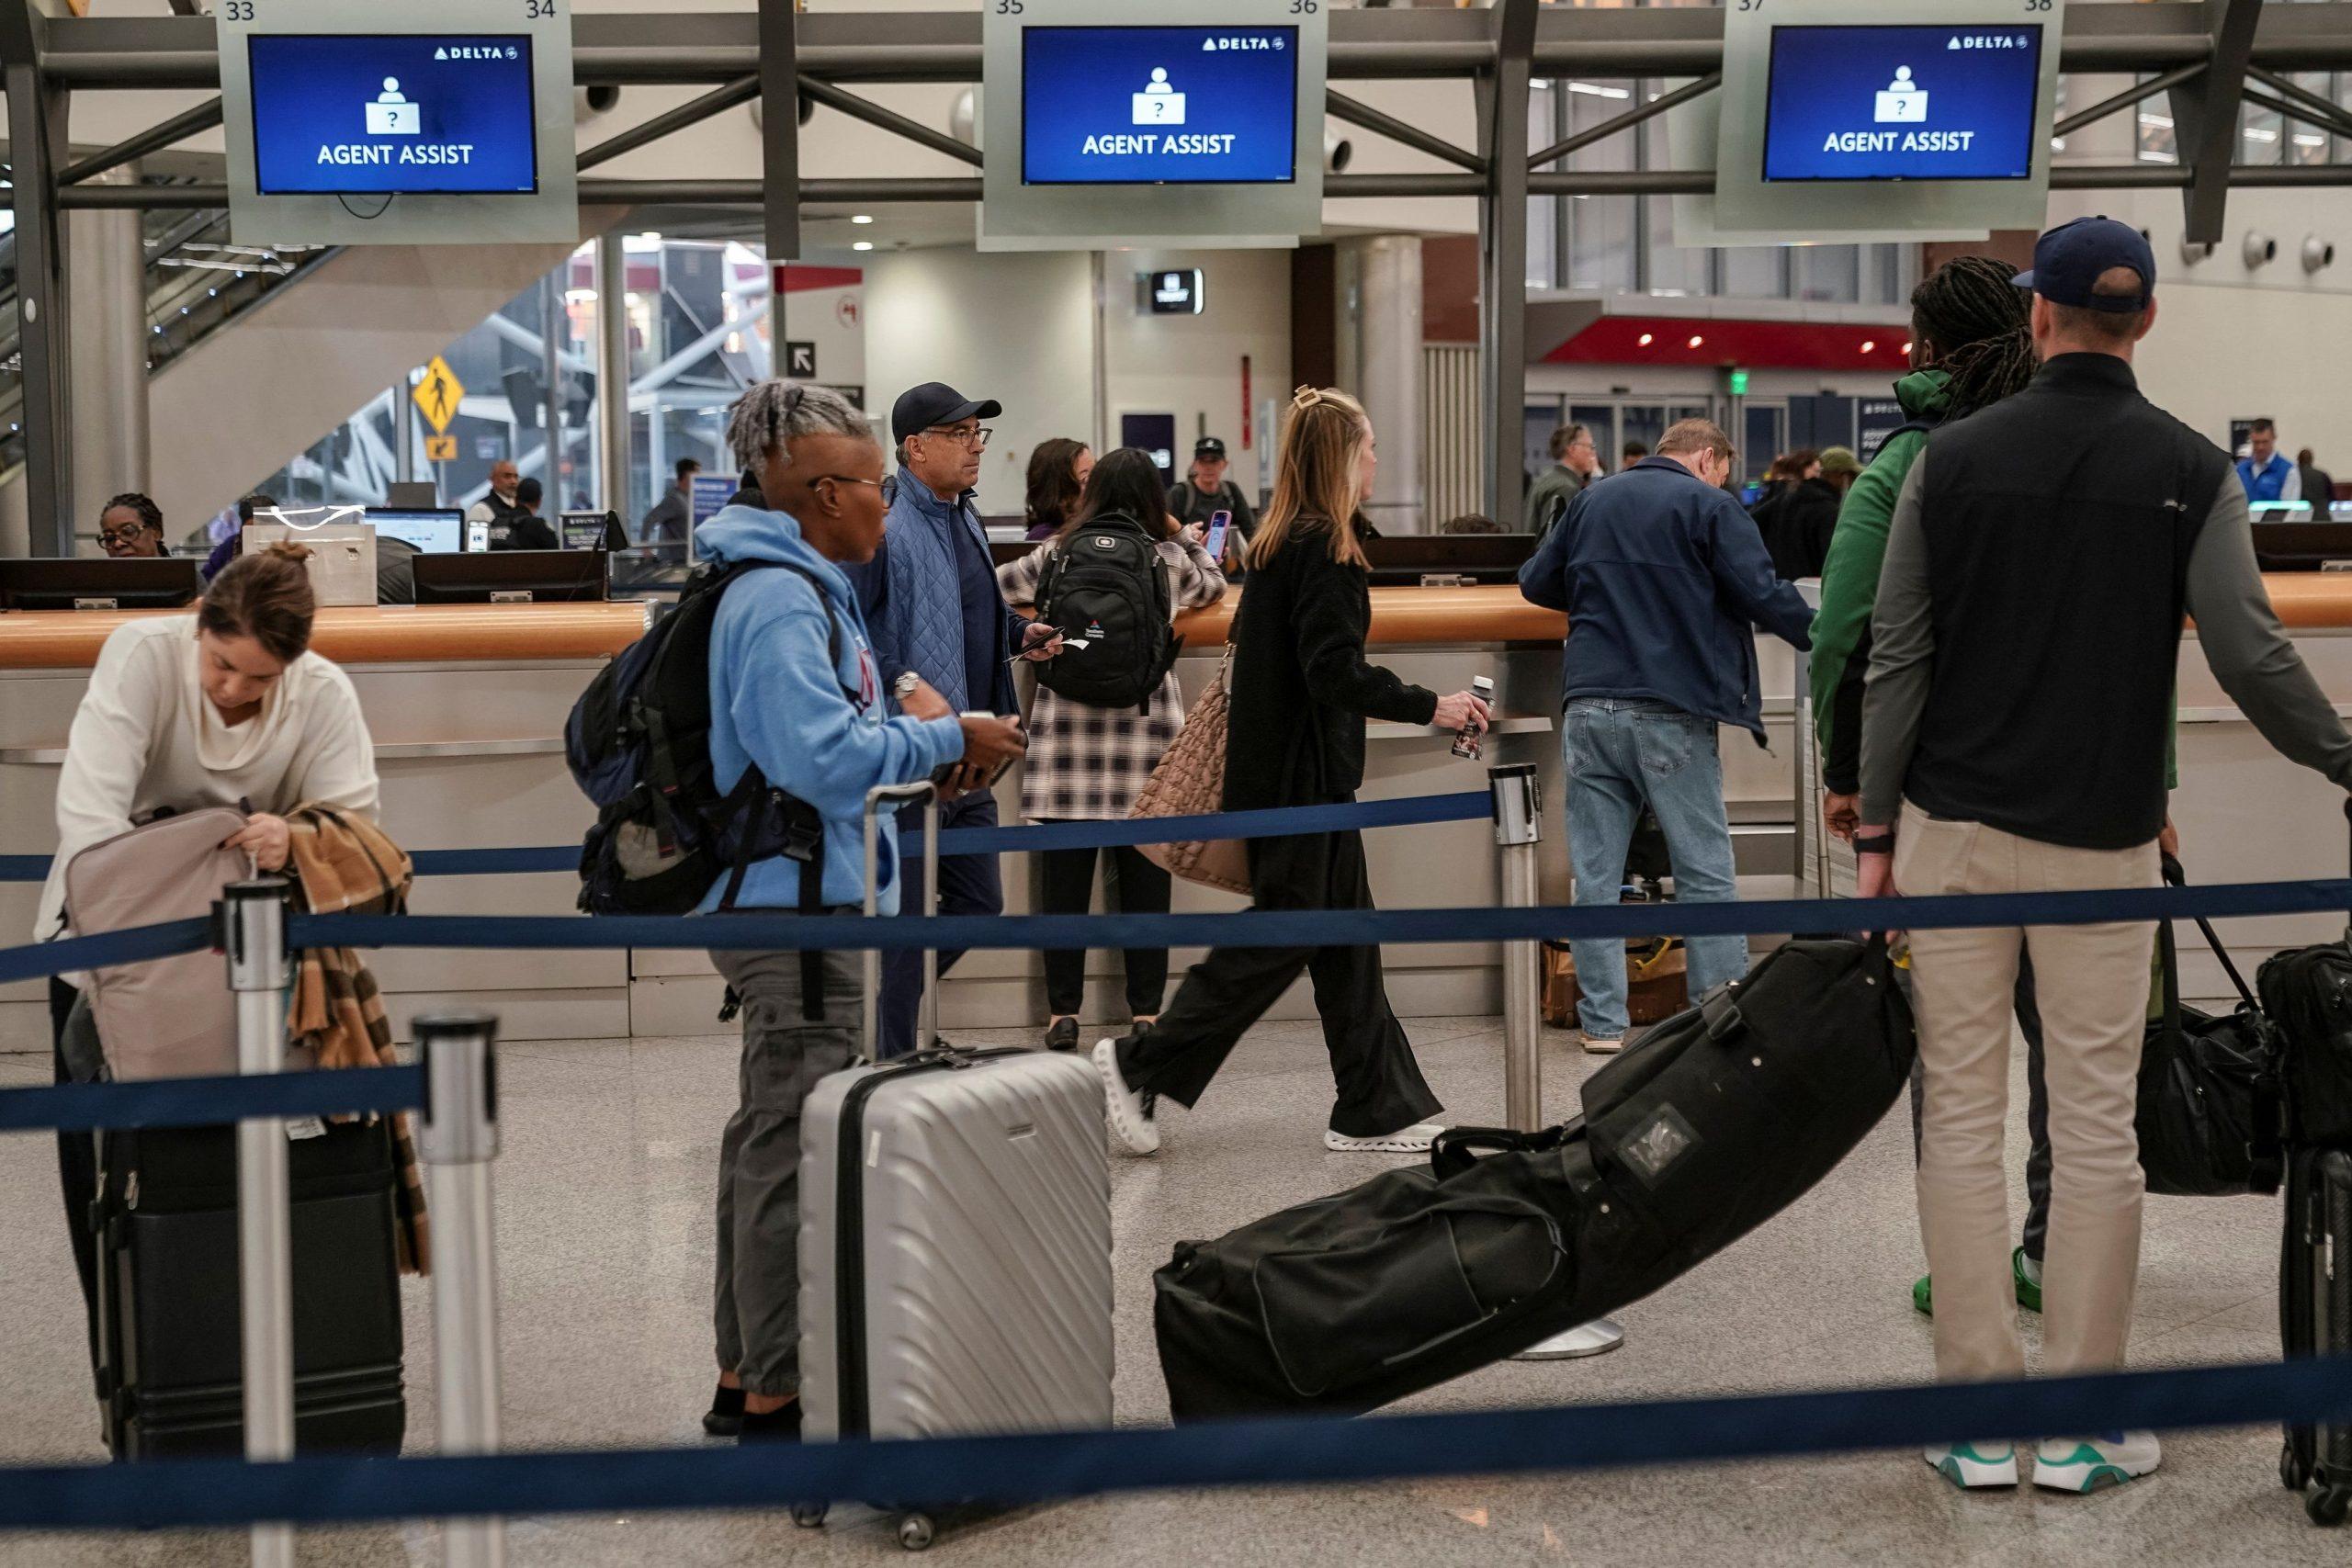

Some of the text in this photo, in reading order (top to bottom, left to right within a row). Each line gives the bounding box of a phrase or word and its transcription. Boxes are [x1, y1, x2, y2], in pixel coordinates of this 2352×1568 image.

[226, 1, 254, 21] 33
[526, 0, 557, 18] 34
[996, 0, 1023, 15] 35
[1289, 0, 1317, 15] 36
[1218, 37, 1270, 50] DELTA
[1963, 36, 2013, 49] DELTA
[450, 47, 503, 59] DELTA
[1081, 134, 1236, 155] AGENT ASSIST
[1823, 131, 1974, 152] AGENT ASSIST
[317, 144, 474, 164] AGENT ASSIST
